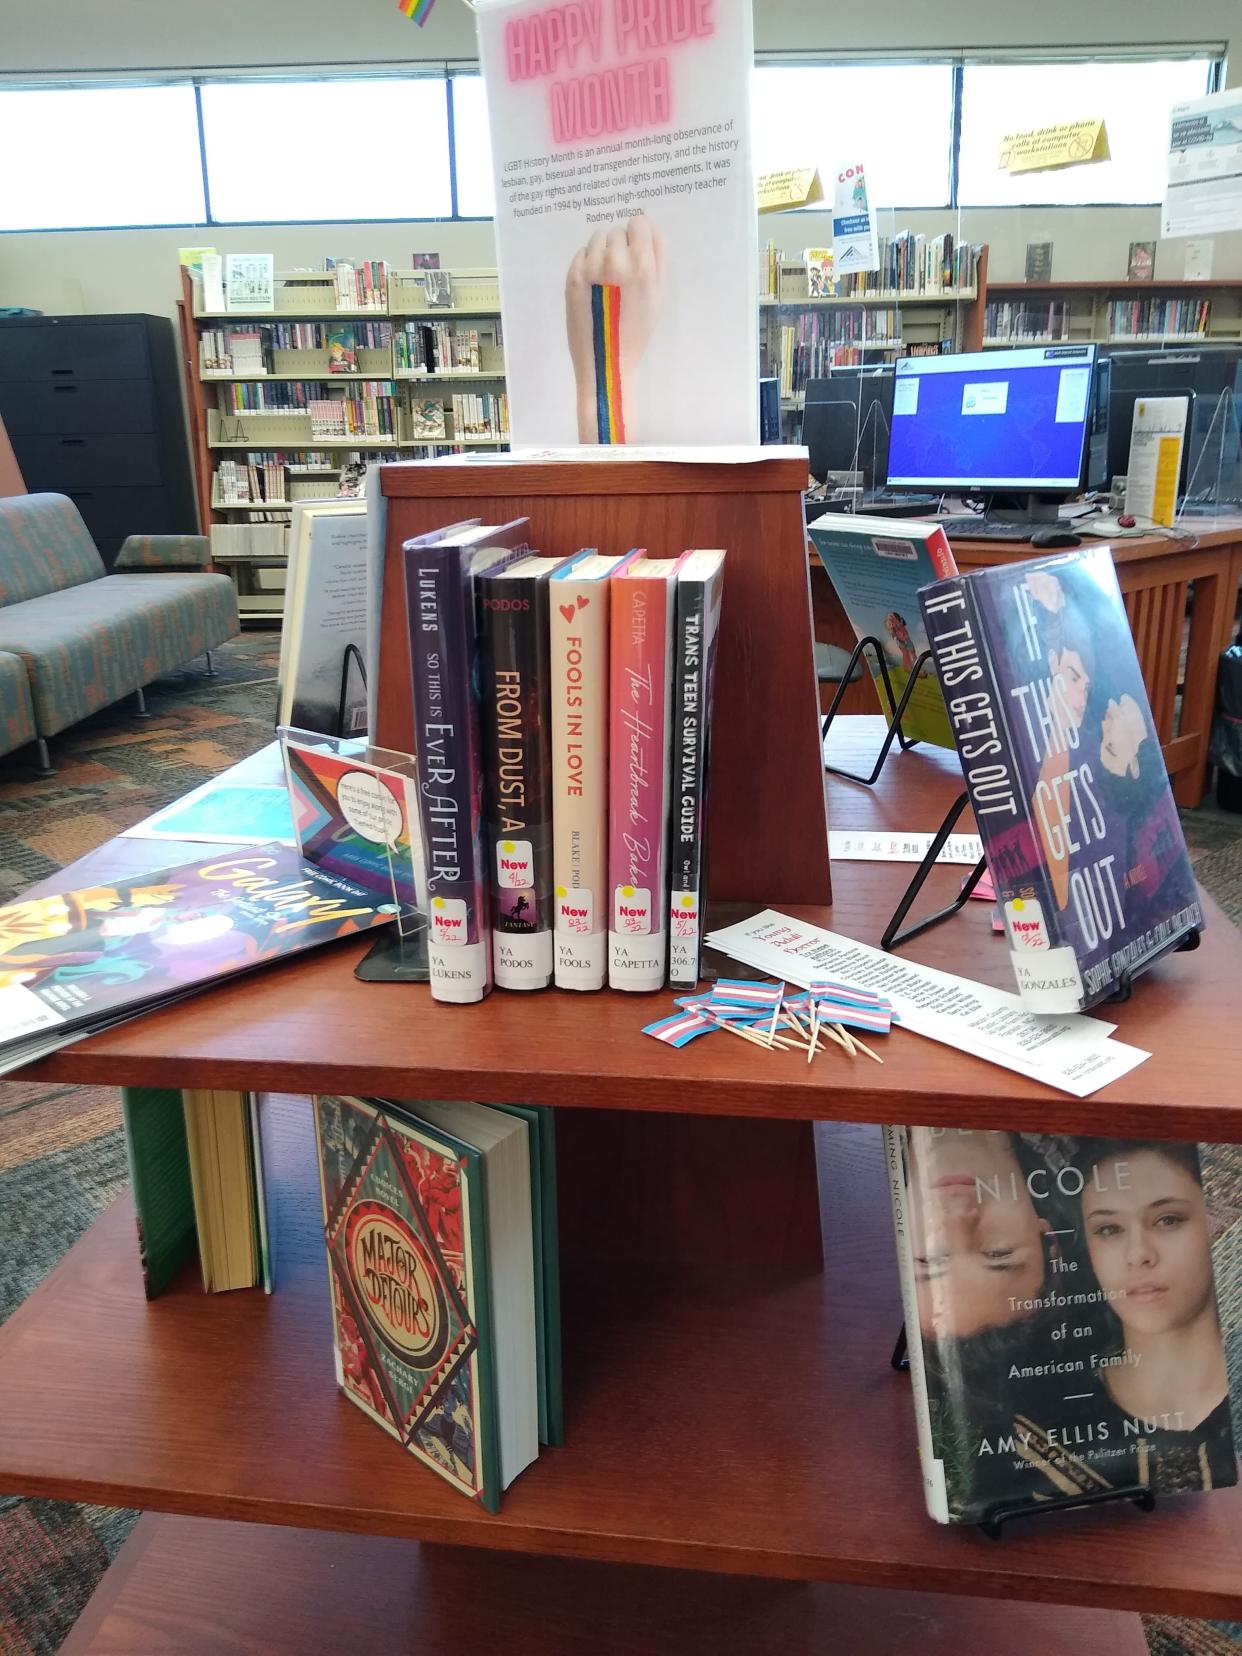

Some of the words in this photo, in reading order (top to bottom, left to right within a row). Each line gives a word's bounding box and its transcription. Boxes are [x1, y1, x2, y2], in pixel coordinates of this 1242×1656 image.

[506, 0, 602, 81] HAPPY
[615, 0, 715, 55] PRIDE
[551, 57, 672, 144] MONTH
[1003, 135, 1014, 143] No
[1037, 125, 1057, 136] drink
[1069, 119, 1096, 132] phone
[1012, 139, 1030, 149] calls
[1031, 137, 1041, 146] at
[1042, 131, 1081, 145] computer
[504, 160, 522, 172] LGBT
[524, 157, 550, 169] History
[551, 151, 576, 163] Month
[577, 150, 584, 159] is
[585, 148, 595, 158] an
[596, 141, 623, 156] annual
[624, 133, 672, 150] month-long
[673, 125, 722, 141] observance
[724, 119, 734, 132] of
[1016, 141, 1068, 156] workstations
[545, 166, 576, 181] bisexual
[577, 165, 592, 176] and
[593, 156, 641, 173] transgender
[642, 151, 672, 164] history,
[674, 146, 691, 159] and
[692, 144, 707, 155] the
[708, 139, 739, 153] history
[509, 191, 517, 203] of
[518, 191, 530, 201] the
[530, 191, 544, 202] gay
[545, 185, 566, 199] rights
[567, 182, 582, 194] and
[583, 177, 610, 191] related
[611, 174, 627, 187] civil
[628, 171, 651, 186] rights
[652, 162, 704, 180] movements.
[705, 160, 712, 171] It
[713, 158, 731, 170] was
[513, 205, 543, 218] founded
[544, 204, 552, 213] in
[553, 200, 571, 212] 1994
[572, 199, 582, 212] by
[583, 194, 616, 207] Missouri
[617, 186, 663, 204] high-school
[664, 182, 693, 195] history
[694, 176, 727, 191] teacher
[586, 211, 615, 224] Rodney
[418, 568, 440, 632] LUKENS
[482, 599, 530, 612] PODOS
[924, 590, 966, 615] IF
[631, 591, 647, 646] CAPETTA
[1012, 583, 1043, 662] IF
[684, 613, 700, 667] TRANS
[934, 620, 983, 687] THIS
[427, 653, 440, 669] SO
[565, 636, 583, 707] FOOLS
[428, 673, 442, 700] THIS
[624, 663, 653, 706] The
[684, 671, 699, 713] TEEN
[430, 706, 443, 718] IS
[495, 671, 523, 739] FROM
[566, 714, 583, 736] IN
[950, 692, 1002, 760] GETS
[1010, 674, 1081, 764] THIS
[620, 708, 654, 826] Heartbreak
[680, 717, 699, 792] SURVIVAL
[498, 748, 526, 811] DUST,
[566, 744, 583, 797] LOVE
[967, 764, 1018, 816] OUT
[501, 817, 526, 833] A
[680, 797, 696, 843] GUIDE
[1033, 767, 1107, 862] GETS
[421, 782, 461, 892] AFTER
[571, 831, 580, 862] BLAKE
[501, 859, 529, 871] New
[683, 859, 691, 873] Owl
[682, 875, 690, 888] and
[198, 858, 374, 933] Galaxy
[1070, 854, 1127, 950] OUT
[435, 915, 462, 927] New
[561, 905, 588, 918] New
[619, 906, 647, 918] New
[671, 908, 697, 920] New
[752, 926, 792, 941] Young
[1012, 920, 1041, 932] New
[499, 946, 513, 956] YA
[559, 945, 573, 956] YA
[614, 946, 628, 957] YA
[672, 945, 687, 955] YA
[770, 933, 802, 948] Adult
[432, 955, 445, 967] YA
[432, 967, 473, 980] LUKENS
[499, 957, 533, 969] PODOS
[559, 957, 591, 969] FOOLS
[613, 958, 660, 969] CAPETTA
[671, 956, 696, 966] 306.7
[671, 967, 679, 977] O
[1018, 967, 1031, 977] YA
[1021, 978, 1077, 990] GONZALES
[1083, 958, 1114, 996] SOPHIE
[975, 1161, 1132, 1204] NICOLE
[892, 1179, 905, 1237] NICOLE
[360, 1227, 421, 1300] MAJOR
[1049, 1257, 1079, 1274] The
[363, 1267, 430, 1340] DETOURS
[1008, 1286, 1128, 1313] Transformation
[1051, 1324, 1067, 1341] of
[1072, 1324, 1093, 1338] an
[1007, 1358, 1084, 1380] American
[1090, 1349, 1143, 1370] Family
[978, 1431, 1032, 1457] AMY
[1047, 1421, 1111, 1448] ELLIS
[1122, 1411, 1186, 1437] NUTT
[1070, 1450, 1085, 1462] the
[1088, 1446, 1128, 1461] Pulitzer
[1130, 1443, 1157, 1454] Prize
